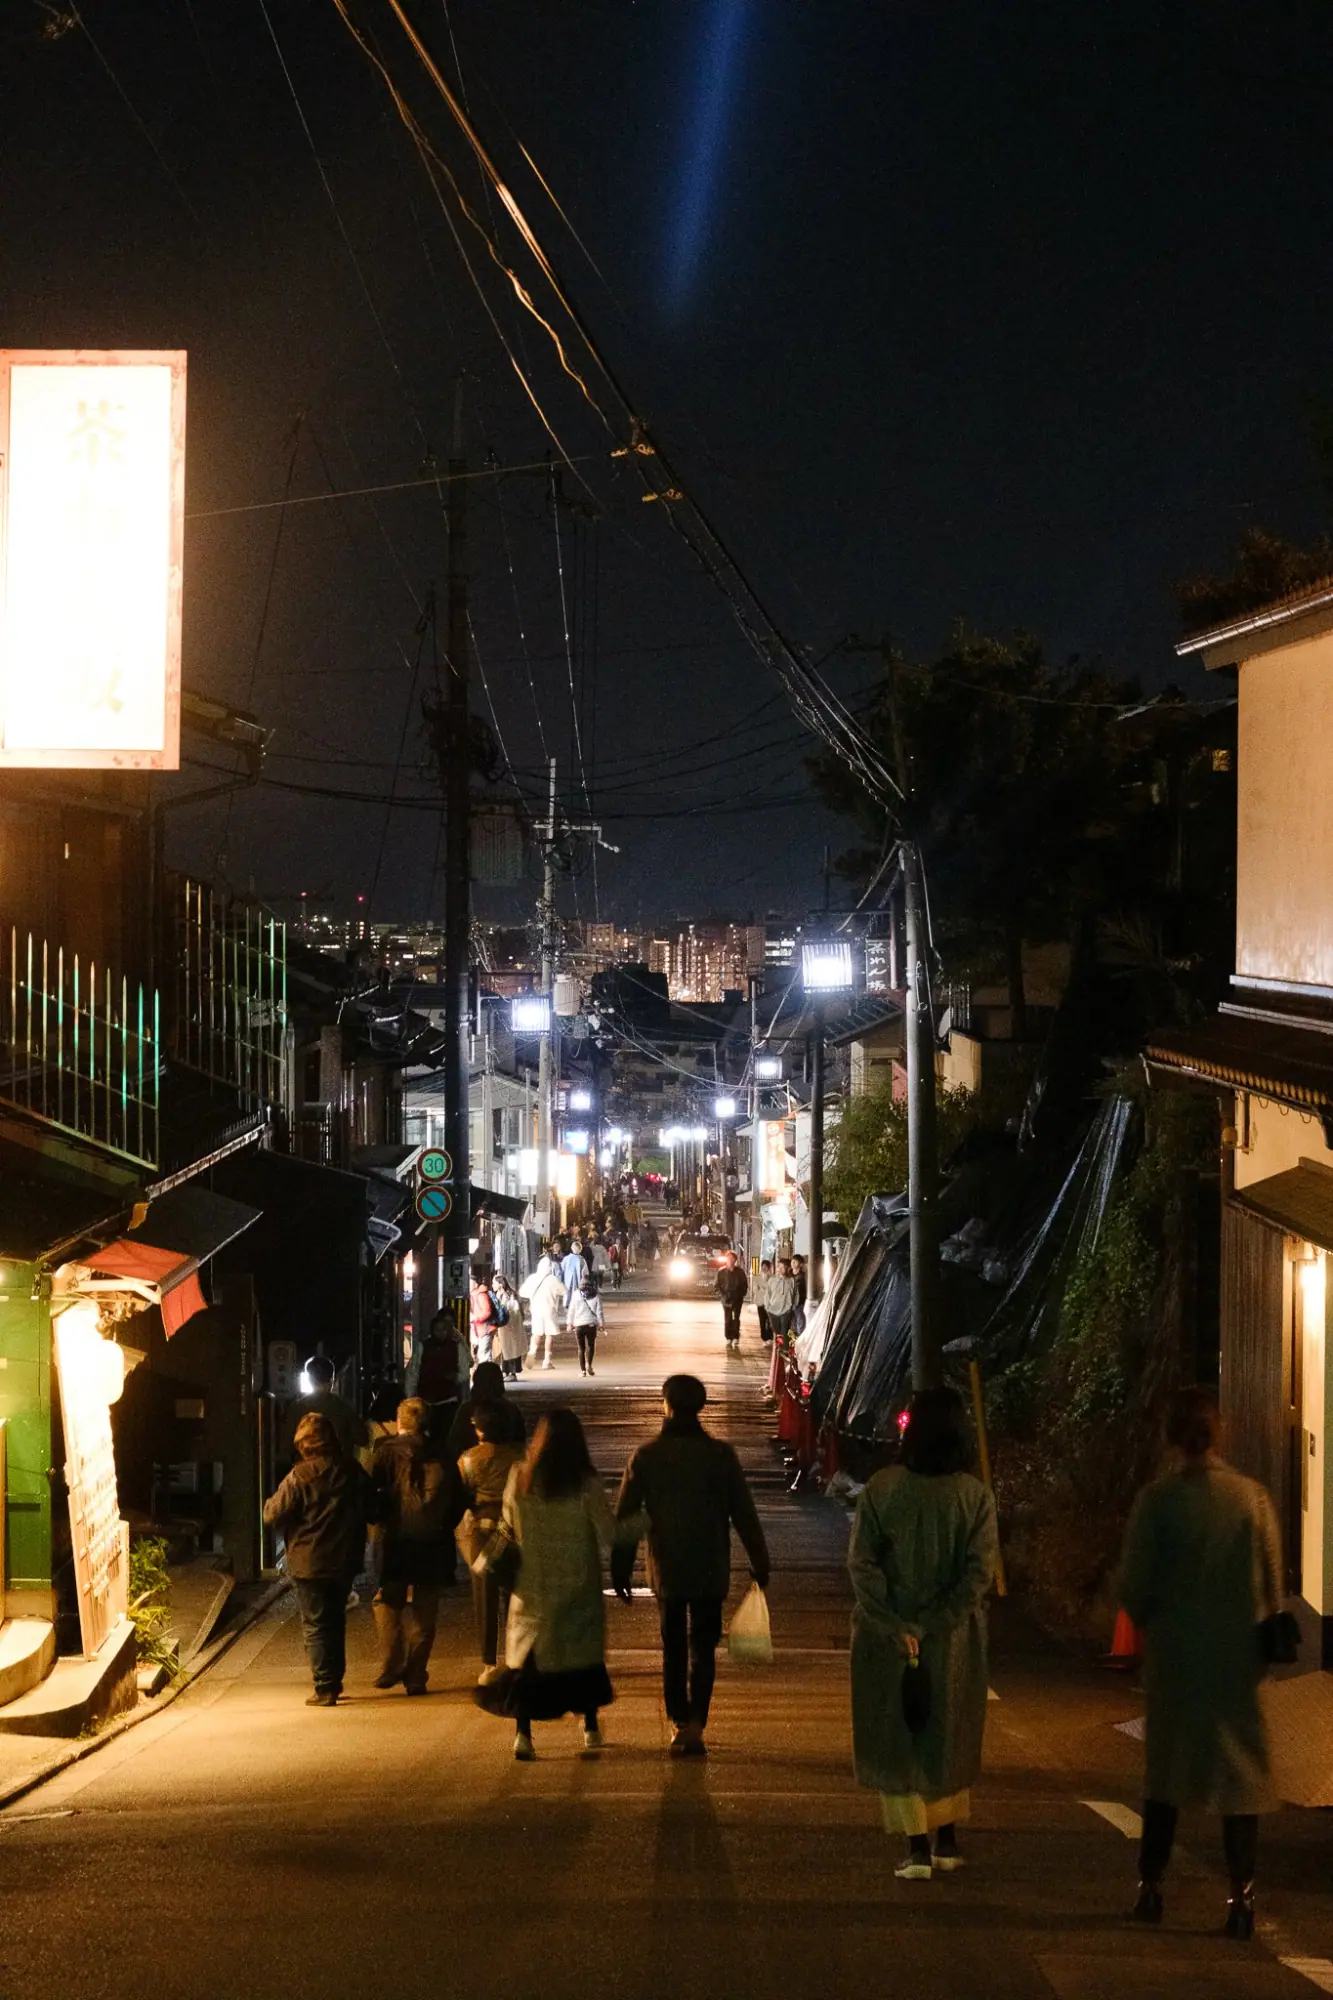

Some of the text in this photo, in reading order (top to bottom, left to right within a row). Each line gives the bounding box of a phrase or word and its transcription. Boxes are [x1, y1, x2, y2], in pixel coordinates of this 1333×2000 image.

[868, 942, 887, 991] 茶わん坂
[425, 1158, 444, 1173] 30
